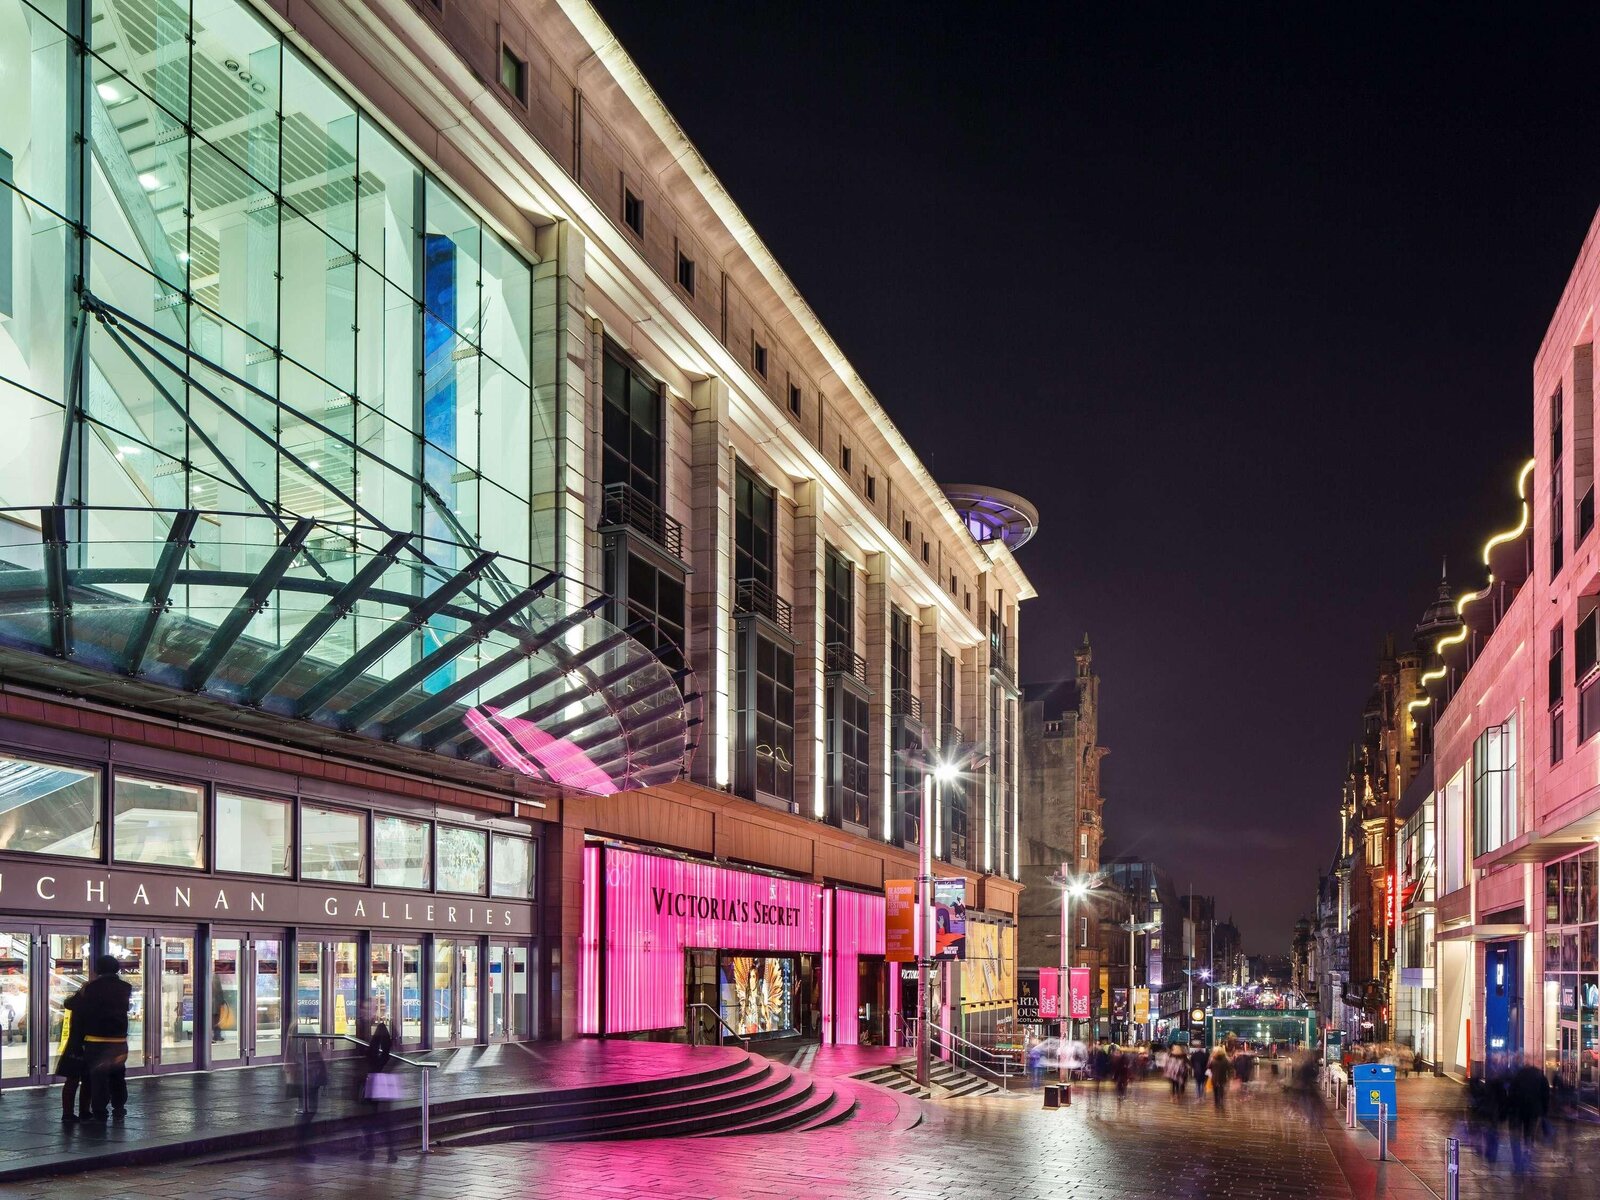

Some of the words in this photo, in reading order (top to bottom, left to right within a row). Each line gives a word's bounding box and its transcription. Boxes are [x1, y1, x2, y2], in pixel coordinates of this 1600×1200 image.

[325, 897, 512, 926] GALLERIES
[652, 886, 749, 923] VICTORIA'S
[754, 900, 801, 927] SECRET
